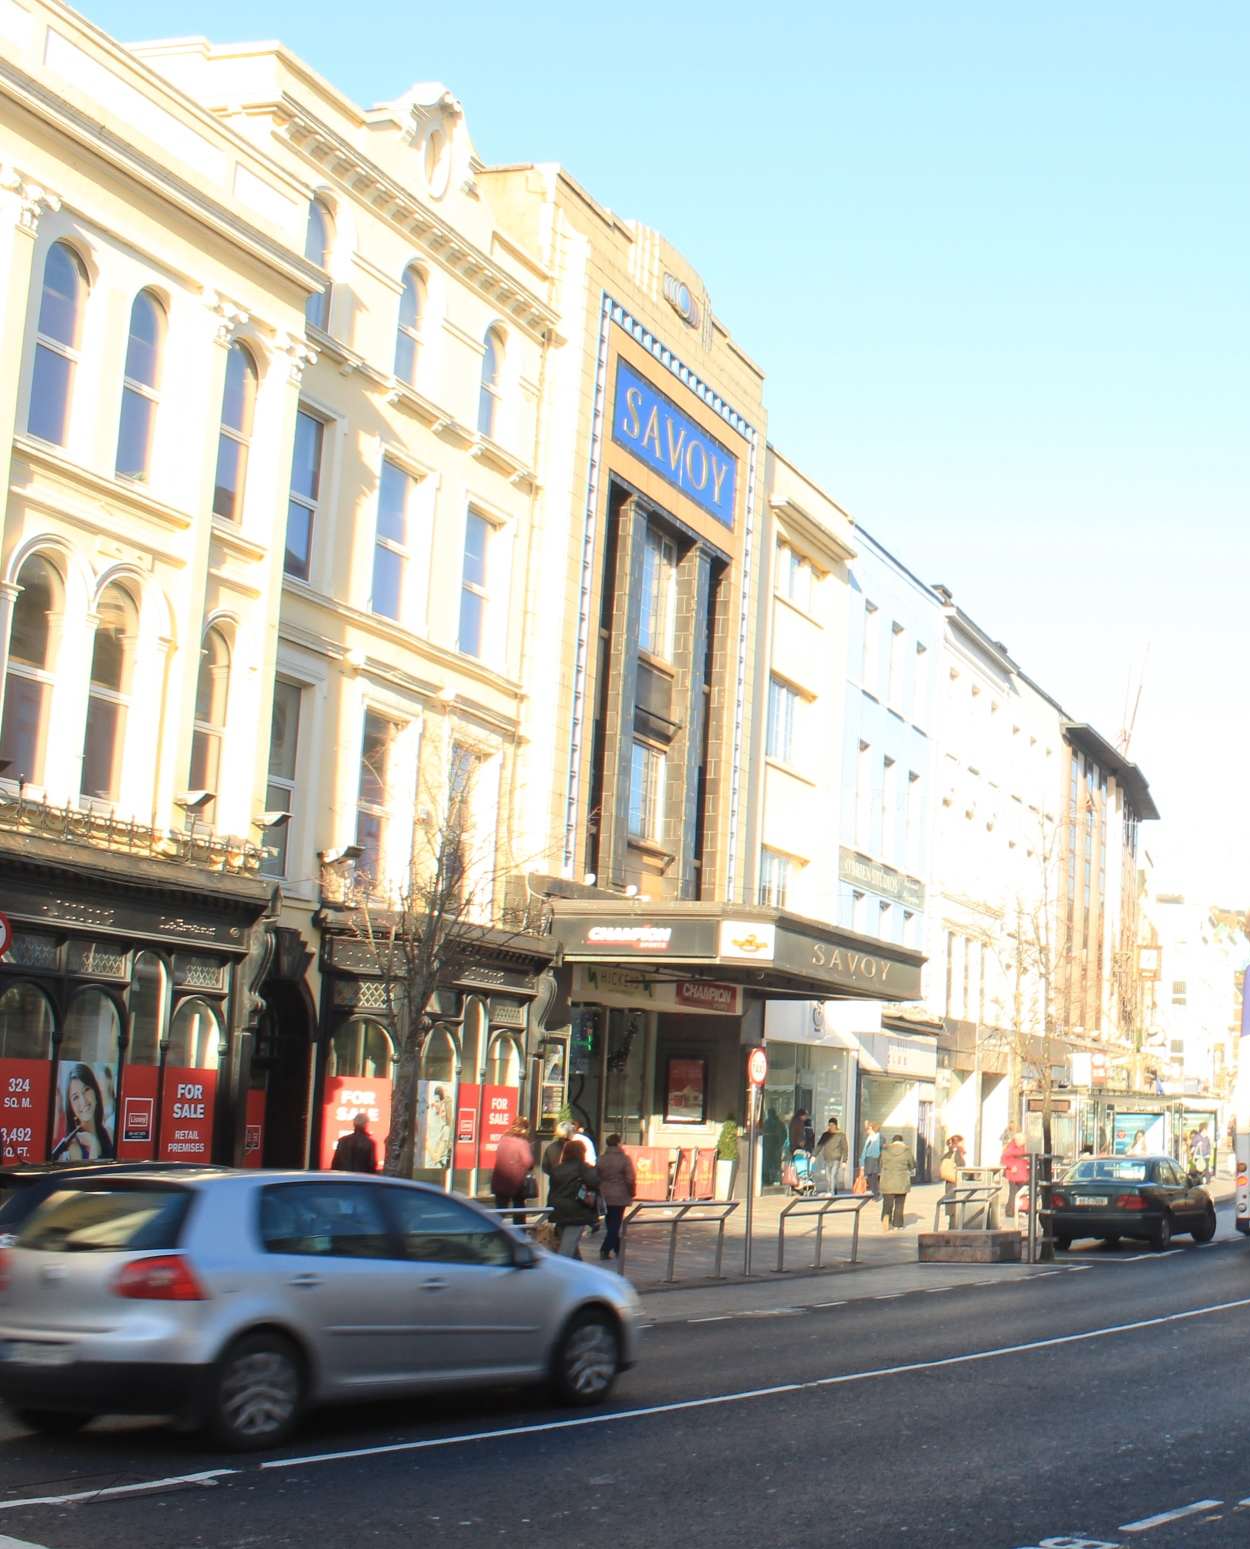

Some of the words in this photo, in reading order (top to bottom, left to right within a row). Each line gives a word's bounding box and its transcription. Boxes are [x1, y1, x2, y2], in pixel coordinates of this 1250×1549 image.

[622, 386, 729, 506] SAVOY
[588, 926, 672, 941] CHAMPION
[811, 943, 891, 982] SAVOY
[683, 983, 732, 1002] CHAMPION
[8, 1078, 31, 1093] 324
[177, 1083, 203, 1100] FOR
[341, 1090, 376, 1105] FOR
[491, 1097, 509, 1110] FOR
[172, 1103, 205, 1119] SALE
[489, 1112, 509, 1125] SALE
[174, 1130, 199, 1140] RETAIL
[167, 1143, 205, 1153] PREMISES
